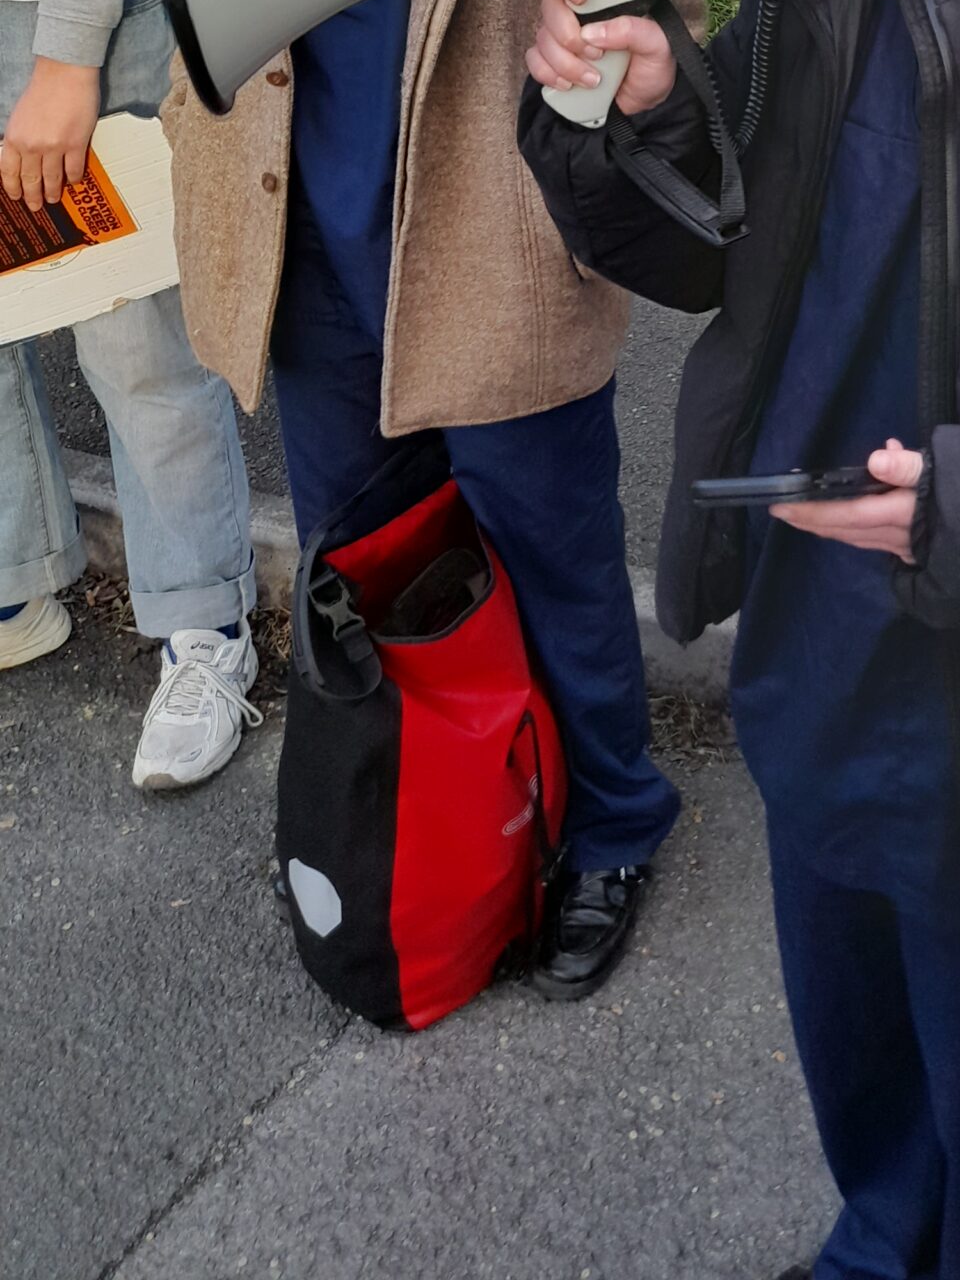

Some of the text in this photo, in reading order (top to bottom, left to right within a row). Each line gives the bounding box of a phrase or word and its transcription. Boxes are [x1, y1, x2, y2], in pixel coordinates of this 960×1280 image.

[67, 183, 82, 206] FIELD
[77, 206, 100, 236] CLOSED
[78, 187, 94, 204] TO
[86, 205, 111, 233] KEEP
[83, 170, 121, 231] ONSTRATION
